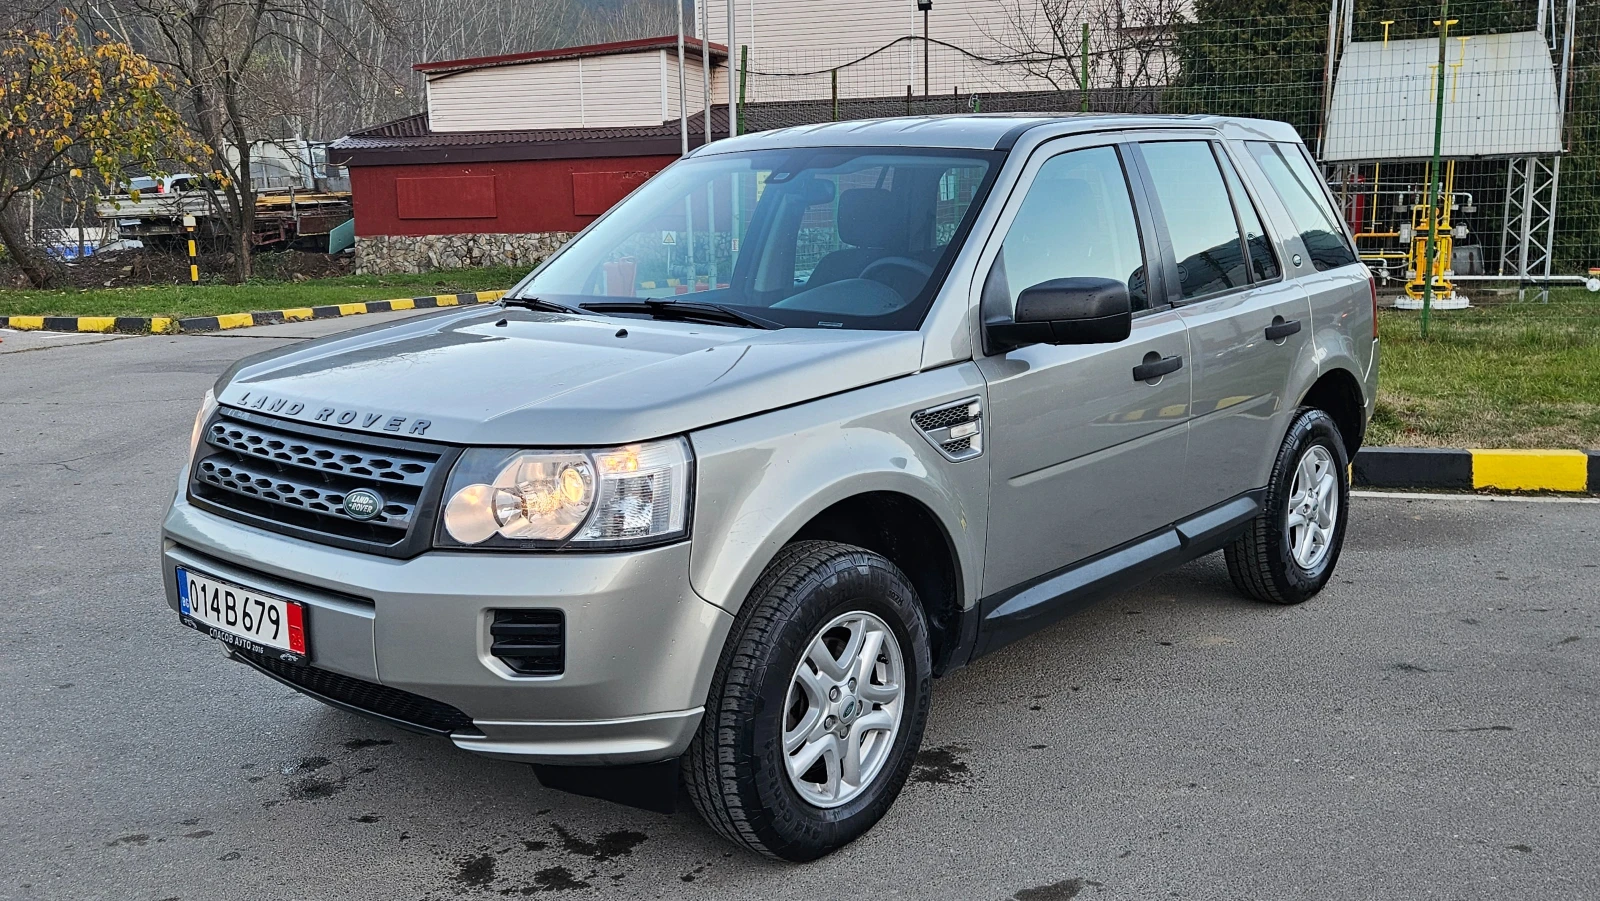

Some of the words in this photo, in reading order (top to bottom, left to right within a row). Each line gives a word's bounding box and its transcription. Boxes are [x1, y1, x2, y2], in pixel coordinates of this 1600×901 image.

[237, 392, 304, 416] LAND
[314, 406, 431, 436] ROVER
[351, 494, 370, 504] LAND
[351, 502, 373, 514] ROVER
[189, 579, 280, 640] 014B679
[209, 627, 233, 644] СПАСОВ
